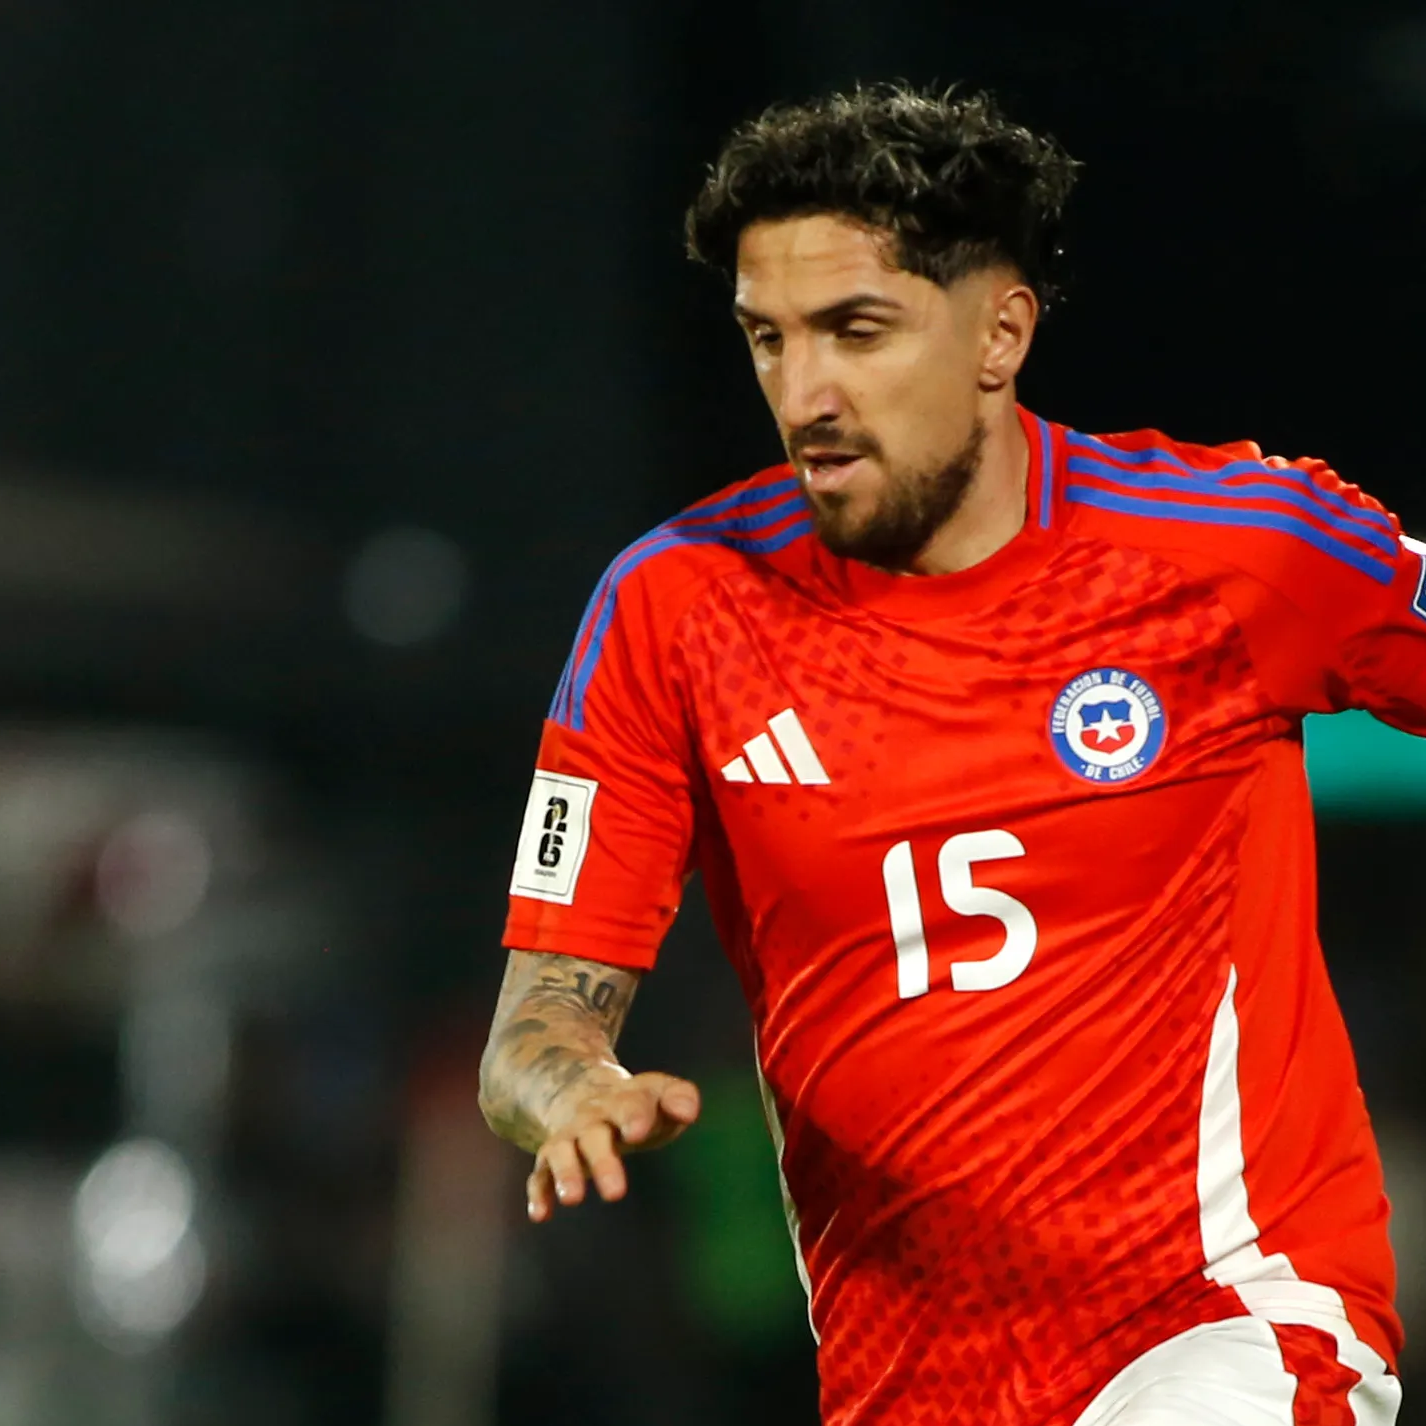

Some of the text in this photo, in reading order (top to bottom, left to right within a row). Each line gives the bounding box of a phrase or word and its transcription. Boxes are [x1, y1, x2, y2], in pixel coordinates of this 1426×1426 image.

[1109, 670, 1126, 685] DE
[1129, 679, 1162, 722] FUTBOL
[1084, 757, 1144, 780] DE CHILE
[882, 828, 1038, 999] 15
